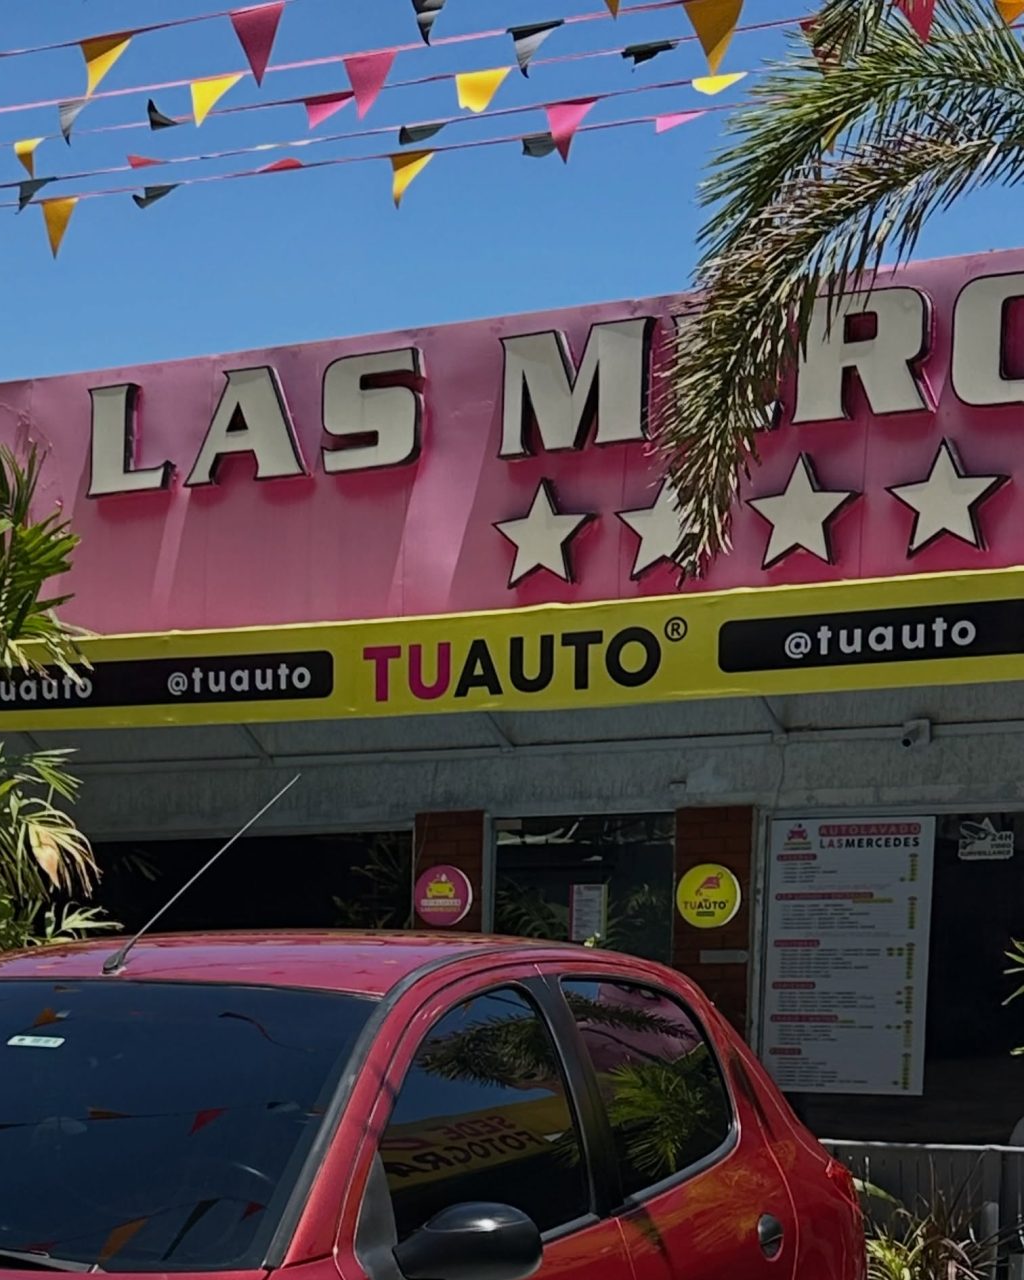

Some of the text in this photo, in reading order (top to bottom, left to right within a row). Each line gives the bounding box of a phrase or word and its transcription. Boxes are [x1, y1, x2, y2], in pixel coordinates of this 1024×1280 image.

[85, 272, 1024, 497] LAS MRC
[784, 617, 977, 659] @tuauto
[167, 662, 312, 696] @tuauto
